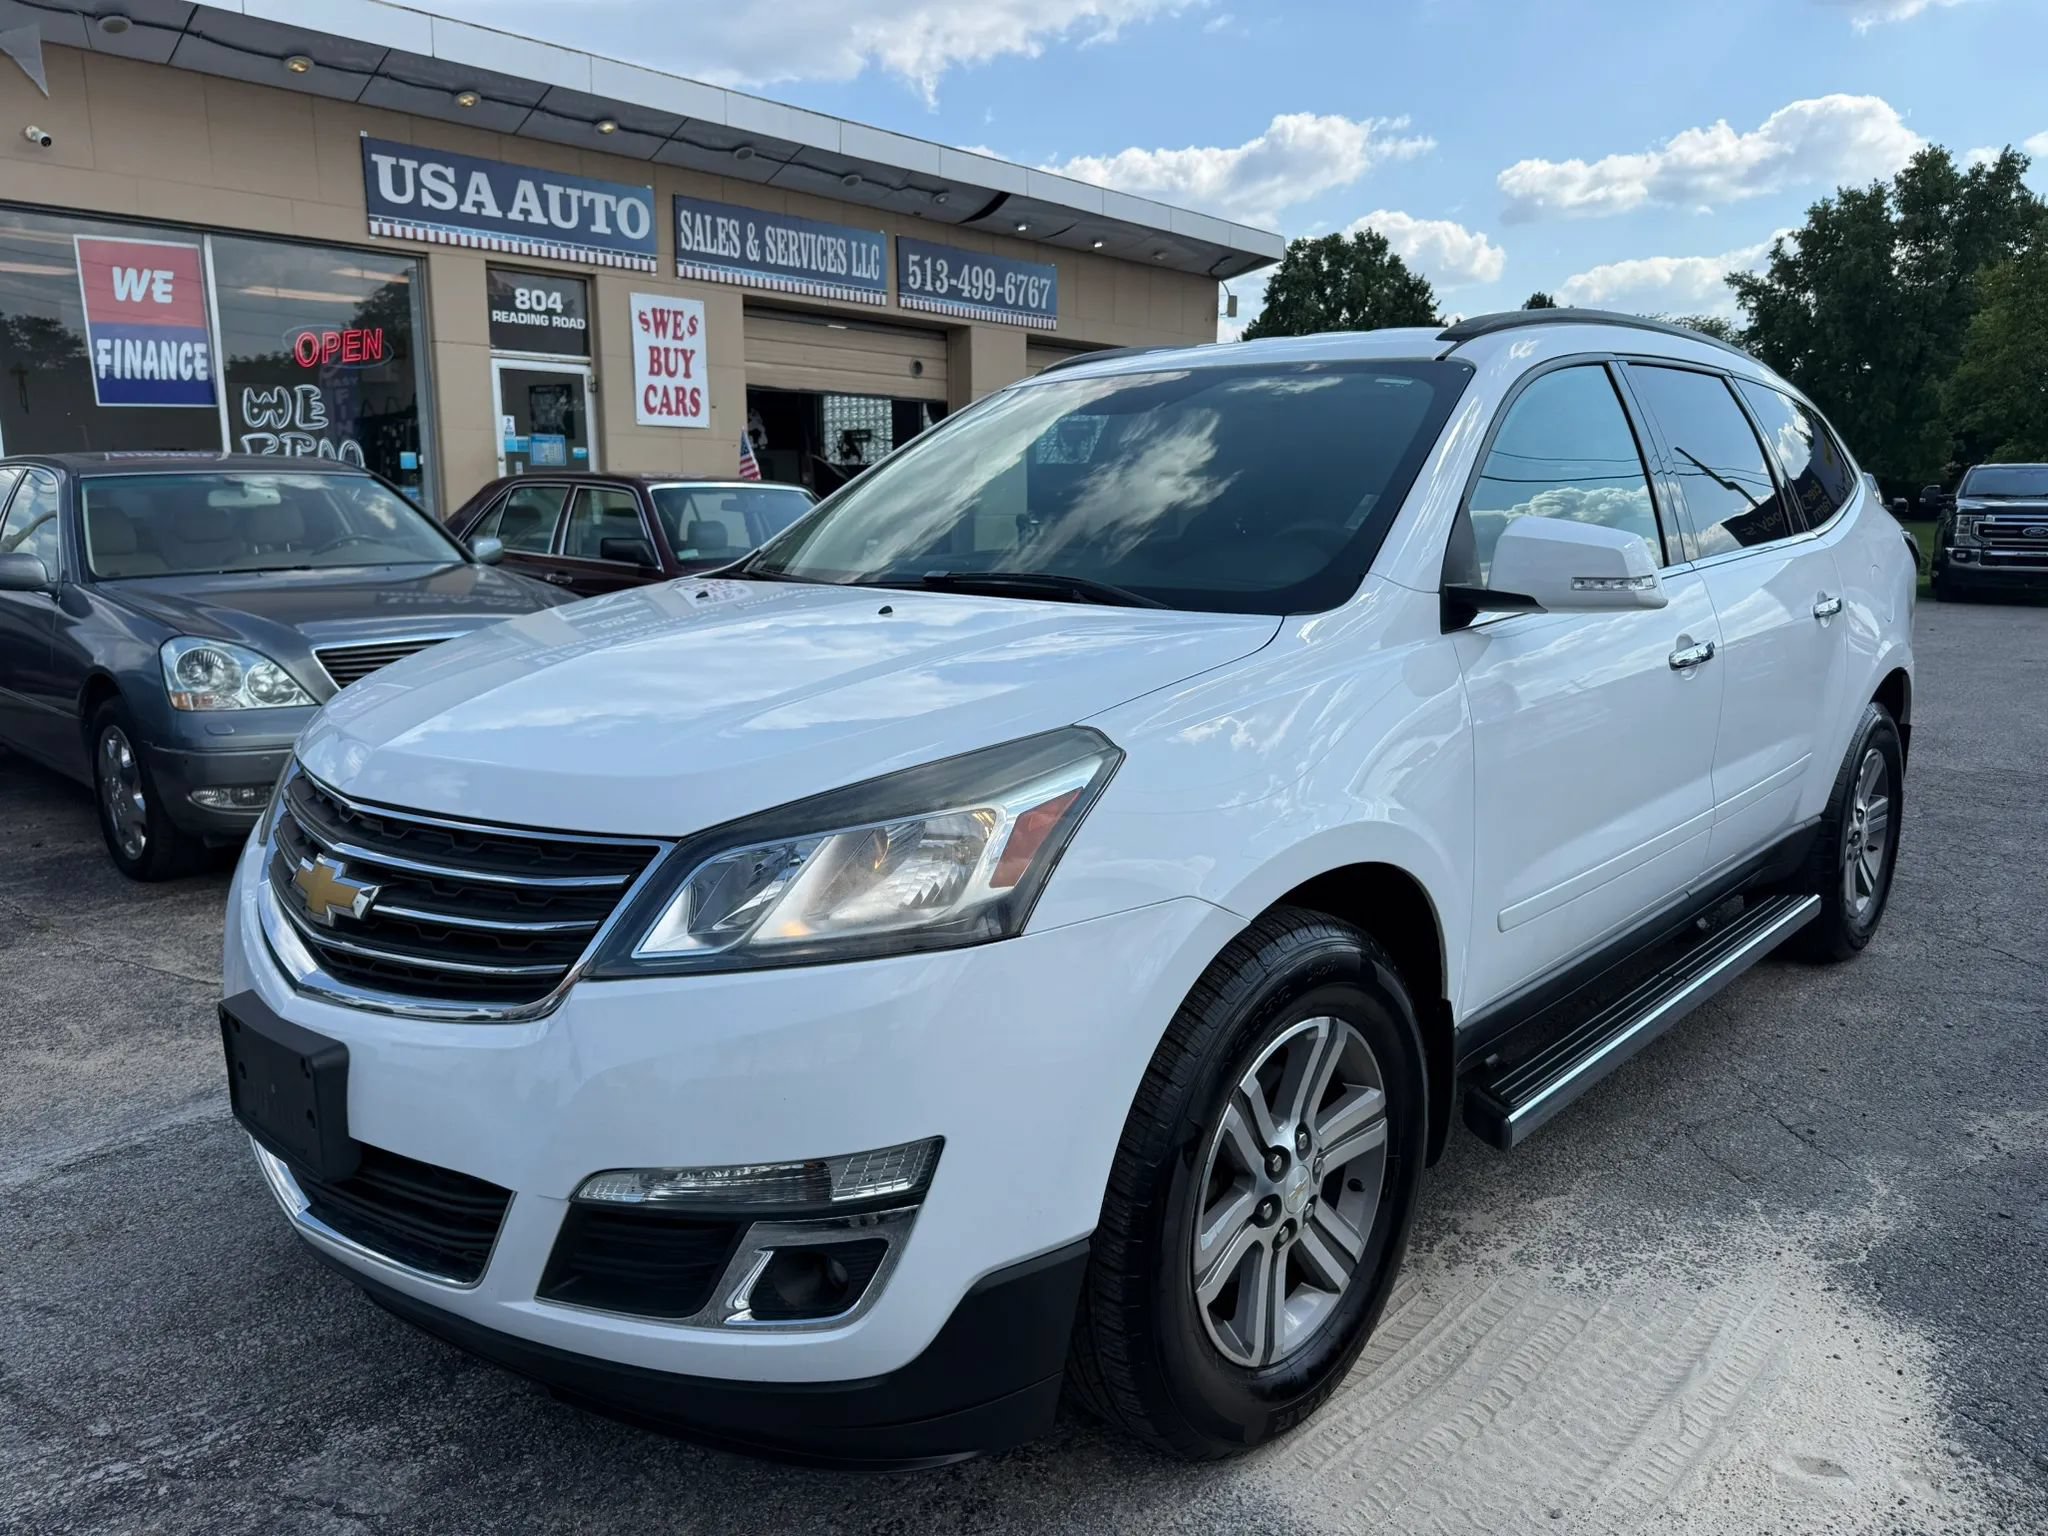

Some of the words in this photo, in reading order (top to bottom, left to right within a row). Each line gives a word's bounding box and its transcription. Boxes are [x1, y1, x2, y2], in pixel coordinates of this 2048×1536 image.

[371, 153, 502, 218] USA
[507, 179, 650, 240] AUTO
[680, 210, 741, 259] SALES
[746, 222, 760, 262] &
[765, 226, 847, 276] SERVICES
[851, 241, 880, 281] LLC
[112, 266, 174, 304] WE
[514, 288, 563, 313] 804
[908, 254, 1051, 309] 513-499-6767
[492, 310, 549, 327] READING
[552, 316, 586, 330] ROAD
[97, 338, 208, 381] FINANCE
[295, 328, 383, 368] OPEN
[648, 345, 696, 379] BUY
[242, 384, 329, 430] WE
[644, 384, 701, 417] CARS
